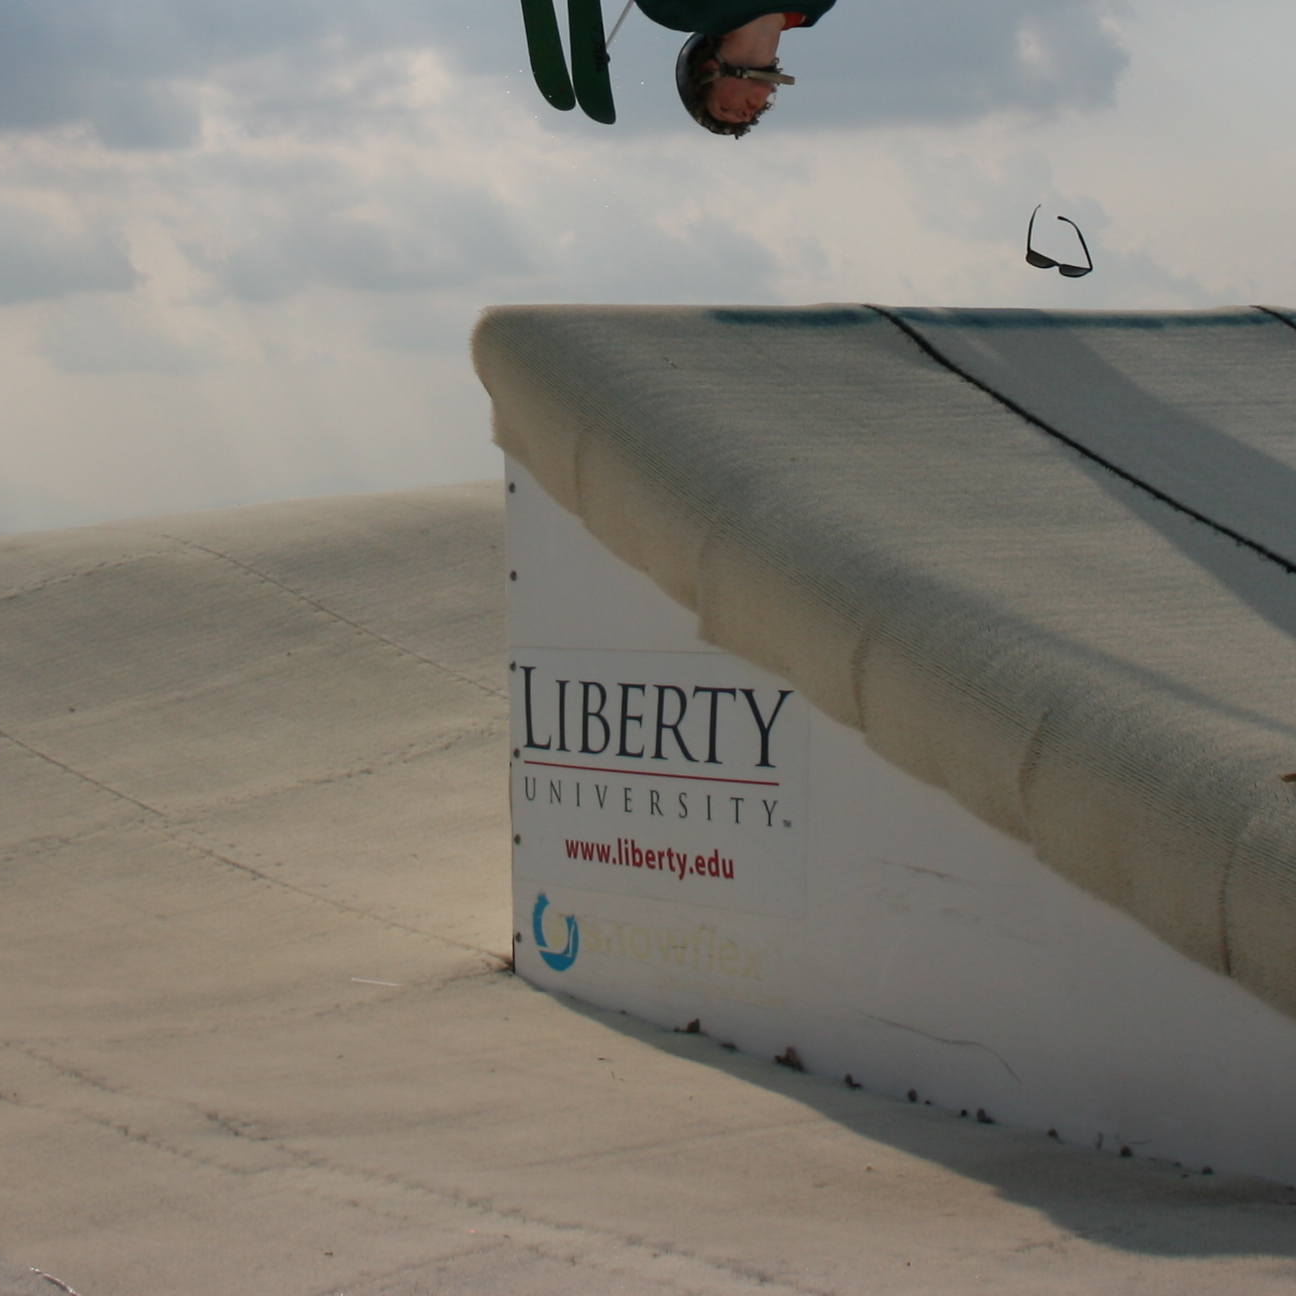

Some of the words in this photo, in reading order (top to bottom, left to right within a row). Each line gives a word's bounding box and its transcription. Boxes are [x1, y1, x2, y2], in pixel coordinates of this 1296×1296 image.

[519, 665, 795, 768] LIBERTY
[524, 776, 779, 827] UNIVERSITY
[564, 837, 735, 881] www.liberty.edu
